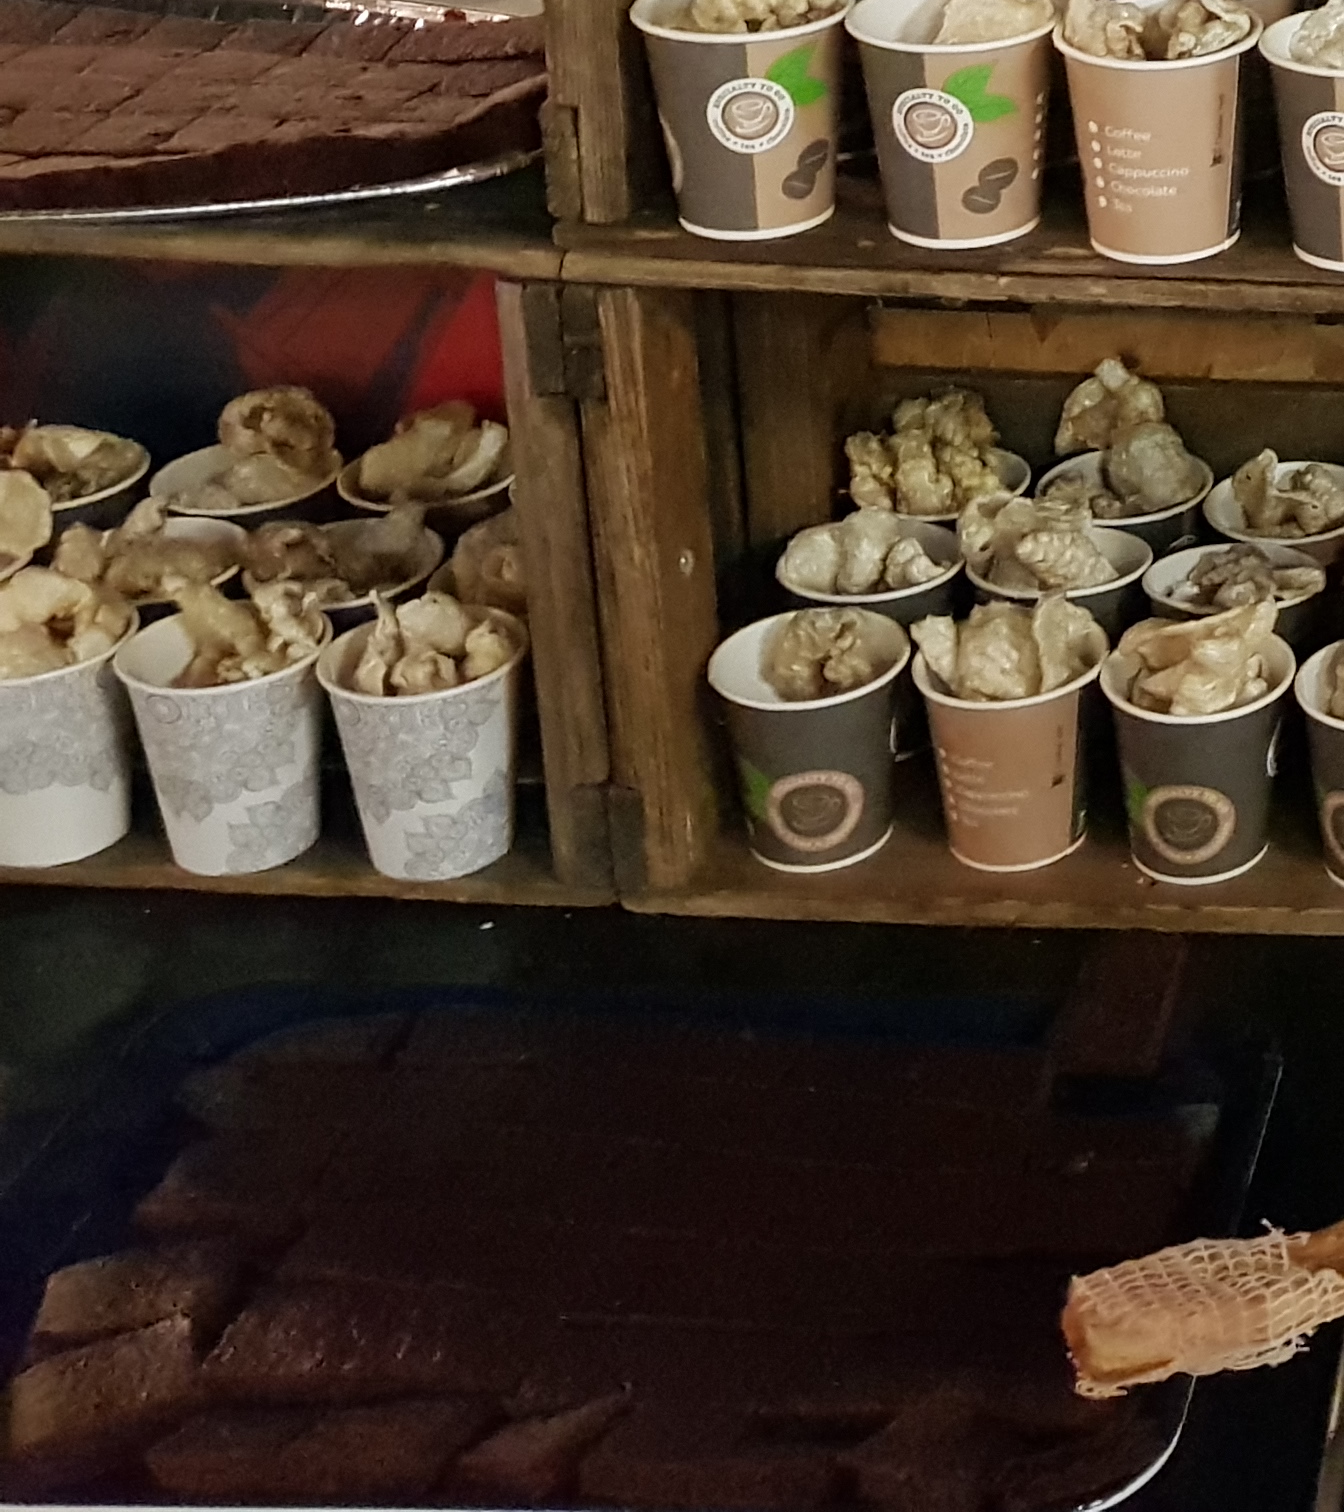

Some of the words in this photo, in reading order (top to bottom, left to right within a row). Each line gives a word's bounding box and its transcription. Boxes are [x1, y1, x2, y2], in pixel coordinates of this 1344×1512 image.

[1104, 125, 1152, 142] Coffee
[1108, 162, 1190, 179] Cappuccino
[1110, 180, 1178, 197] Chocolate
